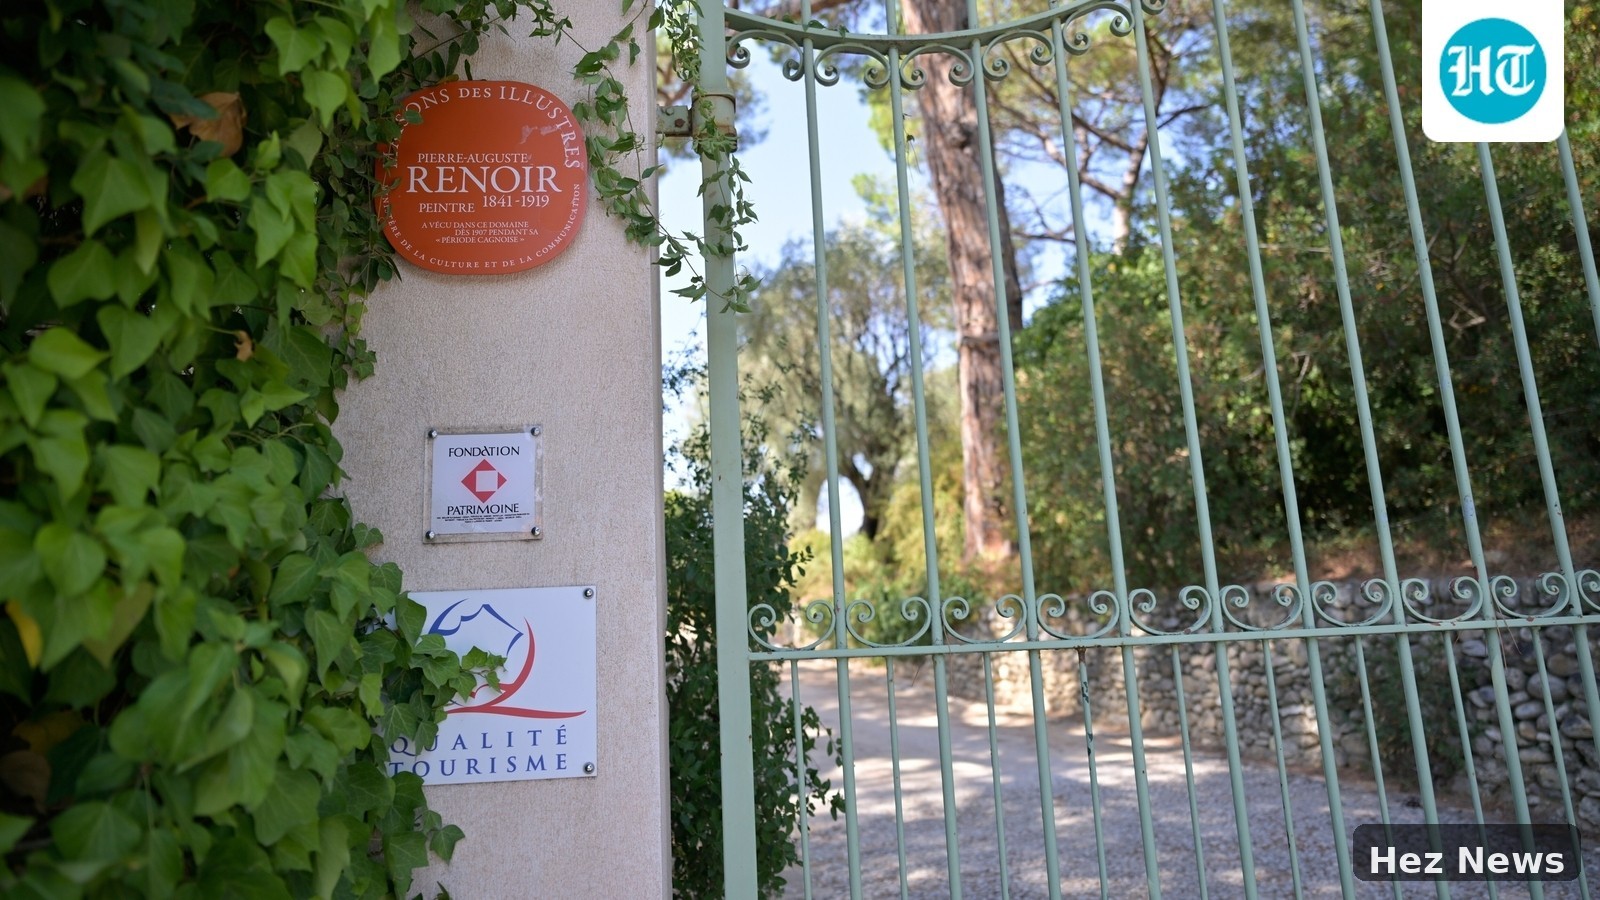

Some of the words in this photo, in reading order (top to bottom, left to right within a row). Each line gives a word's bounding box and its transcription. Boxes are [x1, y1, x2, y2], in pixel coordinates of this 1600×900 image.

[458, 87, 491, 98] DES
[500, 86, 580, 169] ILLUSTRES
[418, 153, 528, 163] PIERRE-AUGUSTE
[405, 165, 562, 193] RENOIR
[419, 203, 475, 213] PEINTRE
[400, 239, 413, 251] DE
[413, 250, 426, 261] LA
[429, 257, 480, 268] CULTURE
[520, 256, 533, 264] LA
[535, 183, 581, 258] COMMUNICATION
[448, 445, 520, 457] FONDATION
[447, 503, 519, 516] PATRIMOINE
[389, 753, 567, 778] TOURISME
